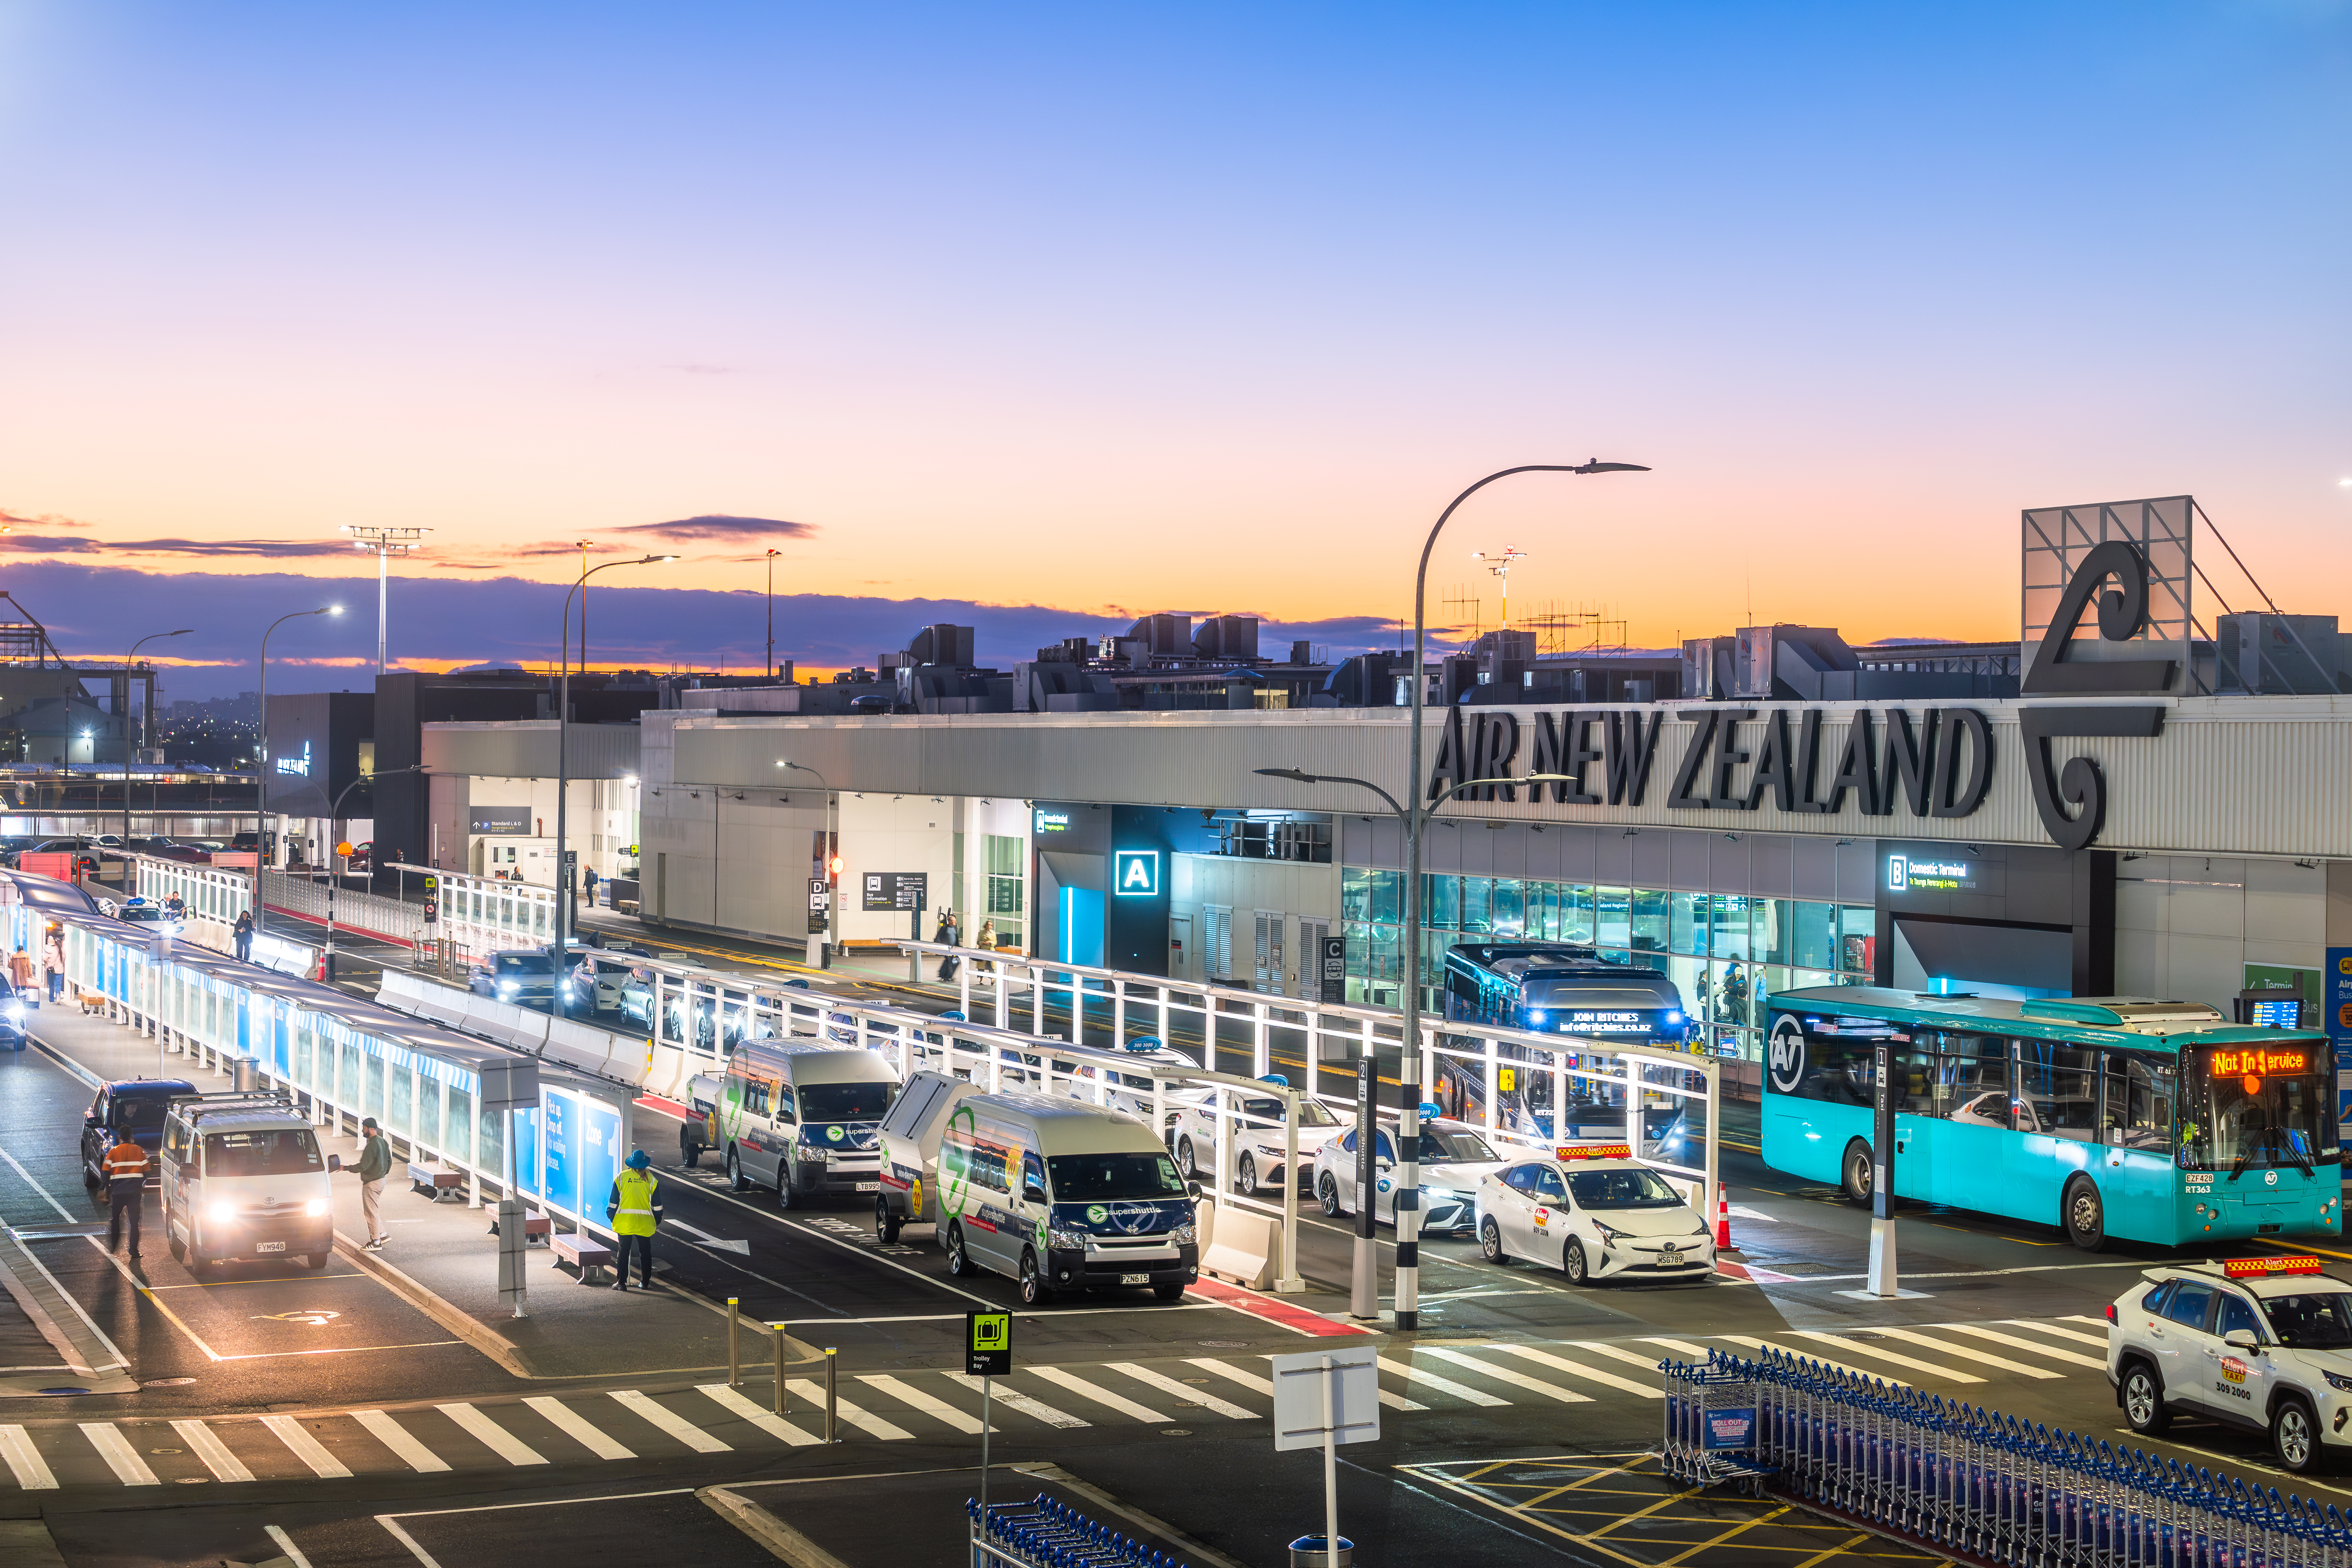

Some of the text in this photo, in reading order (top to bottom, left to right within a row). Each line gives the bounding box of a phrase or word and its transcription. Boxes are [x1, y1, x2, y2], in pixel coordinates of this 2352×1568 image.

[1426, 705, 1993, 817] AIR NEW ZEALAND
[1124, 859, 1150, 887] A
[1894, 862, 1901, 883] B
[1909, 862, 1966, 877] Domestic Terminal
[814, 882, 822, 892] D
[1914, 878, 1927, 887] Taunga
[1927, 879, 1944, 889] Rererangi
[1329, 943, 1340, 956] C
[2264, 979, 2292, 989] Termin
[2303, 999, 2318, 1013] Bus
[1572, 1013, 1639, 1022] JOIN RITCHIES
[1559, 1022, 1652, 1032] info@ritchies.co.nz
[1880, 1052, 1884, 1064] 1
[2215, 1050, 2303, 1074] Not In Service
[1361, 1064, 1365, 1078] 2
[547, 1098, 555, 1115] Pick
[547, 1116, 556, 1136] Drop
[586, 1119, 602, 1146] Zone
[547, 1134, 566, 1158] No waiting
[608, 1122, 619, 1181] 1
[546, 1153, 559, 1171] please.
[2186, 1185, 2210, 1194] RT363
[982, 1208, 1005, 1224] supershuttle
[1109, 1207, 1160, 1216] supershuttle
[1536, 1208, 1548, 1220] Alert
[258, 1243, 284, 1251] FYM948
[1122, 1274, 1148, 1283] PZN615
[2224, 1358, 2244, 1374] Alert
[2224, 1371, 2242, 1382] TAXI
[2216, 1382, 2250, 1400] 309 2000
